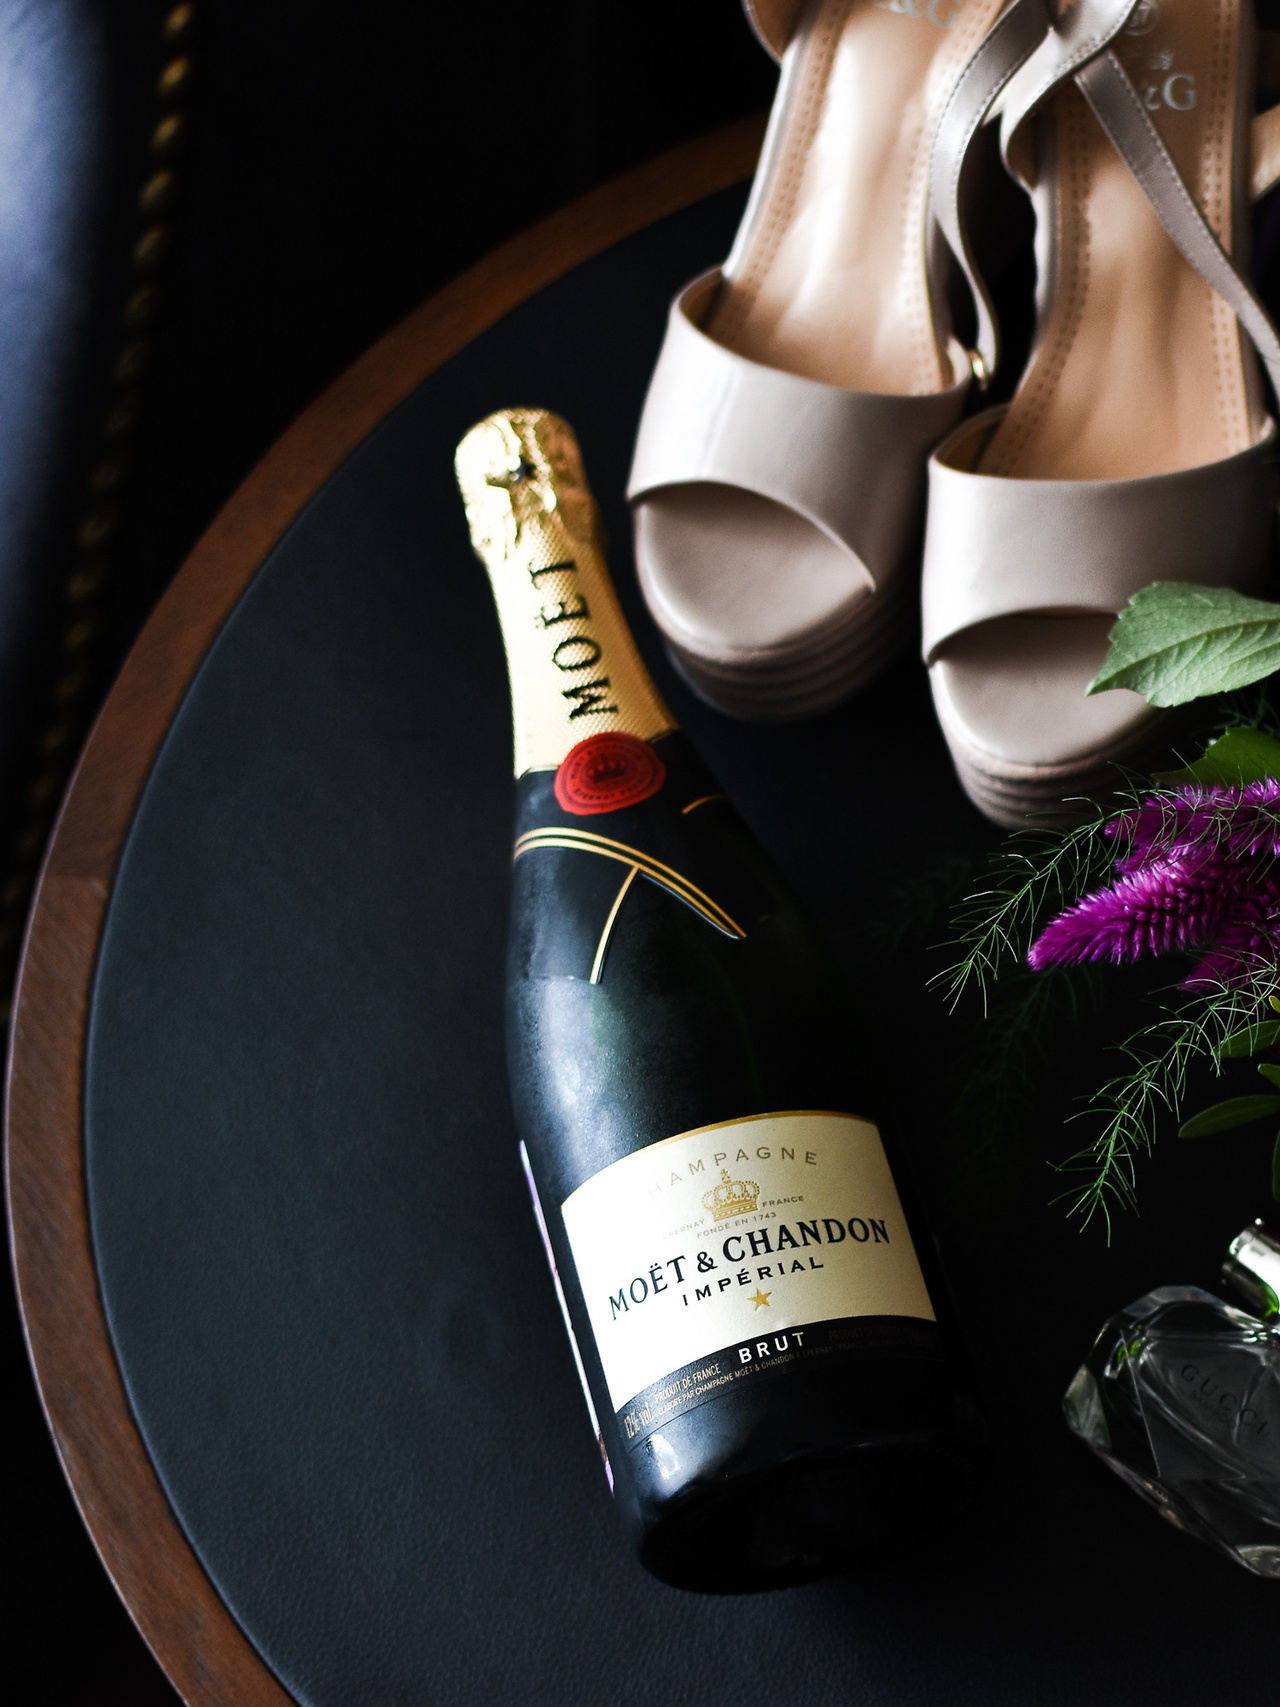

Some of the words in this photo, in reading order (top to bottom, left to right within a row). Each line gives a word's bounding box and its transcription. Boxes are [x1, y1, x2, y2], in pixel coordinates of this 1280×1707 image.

[646, 1146, 818, 1199] HAMPAGNE
[734, 1217, 749, 1227] EN
[753, 1211, 778, 1222] 1743
[761, 1195, 805, 1209] FRANCE
[608, 1254, 687, 1321] MOËT
[696, 1250, 718, 1273] &
[722, 1217, 891, 1263] CHANDON
[682, 1256, 824, 1307] IMPÉRIAL
[738, 1331, 805, 1364] BRUT
[654, 1380, 682, 1404] PRODUIT
[682, 1374, 693, 1388] DE
[692, 1363, 722, 1384] FRANCE
[682, 1389, 695, 1402] PAR
[694, 1372, 734, 1396] CHAMPAGNE
[754, 1363, 760, 1372] &
[761, 1353, 795, 1370] CHANDON
[1180, 1363, 1269, 1436] GUCCI
